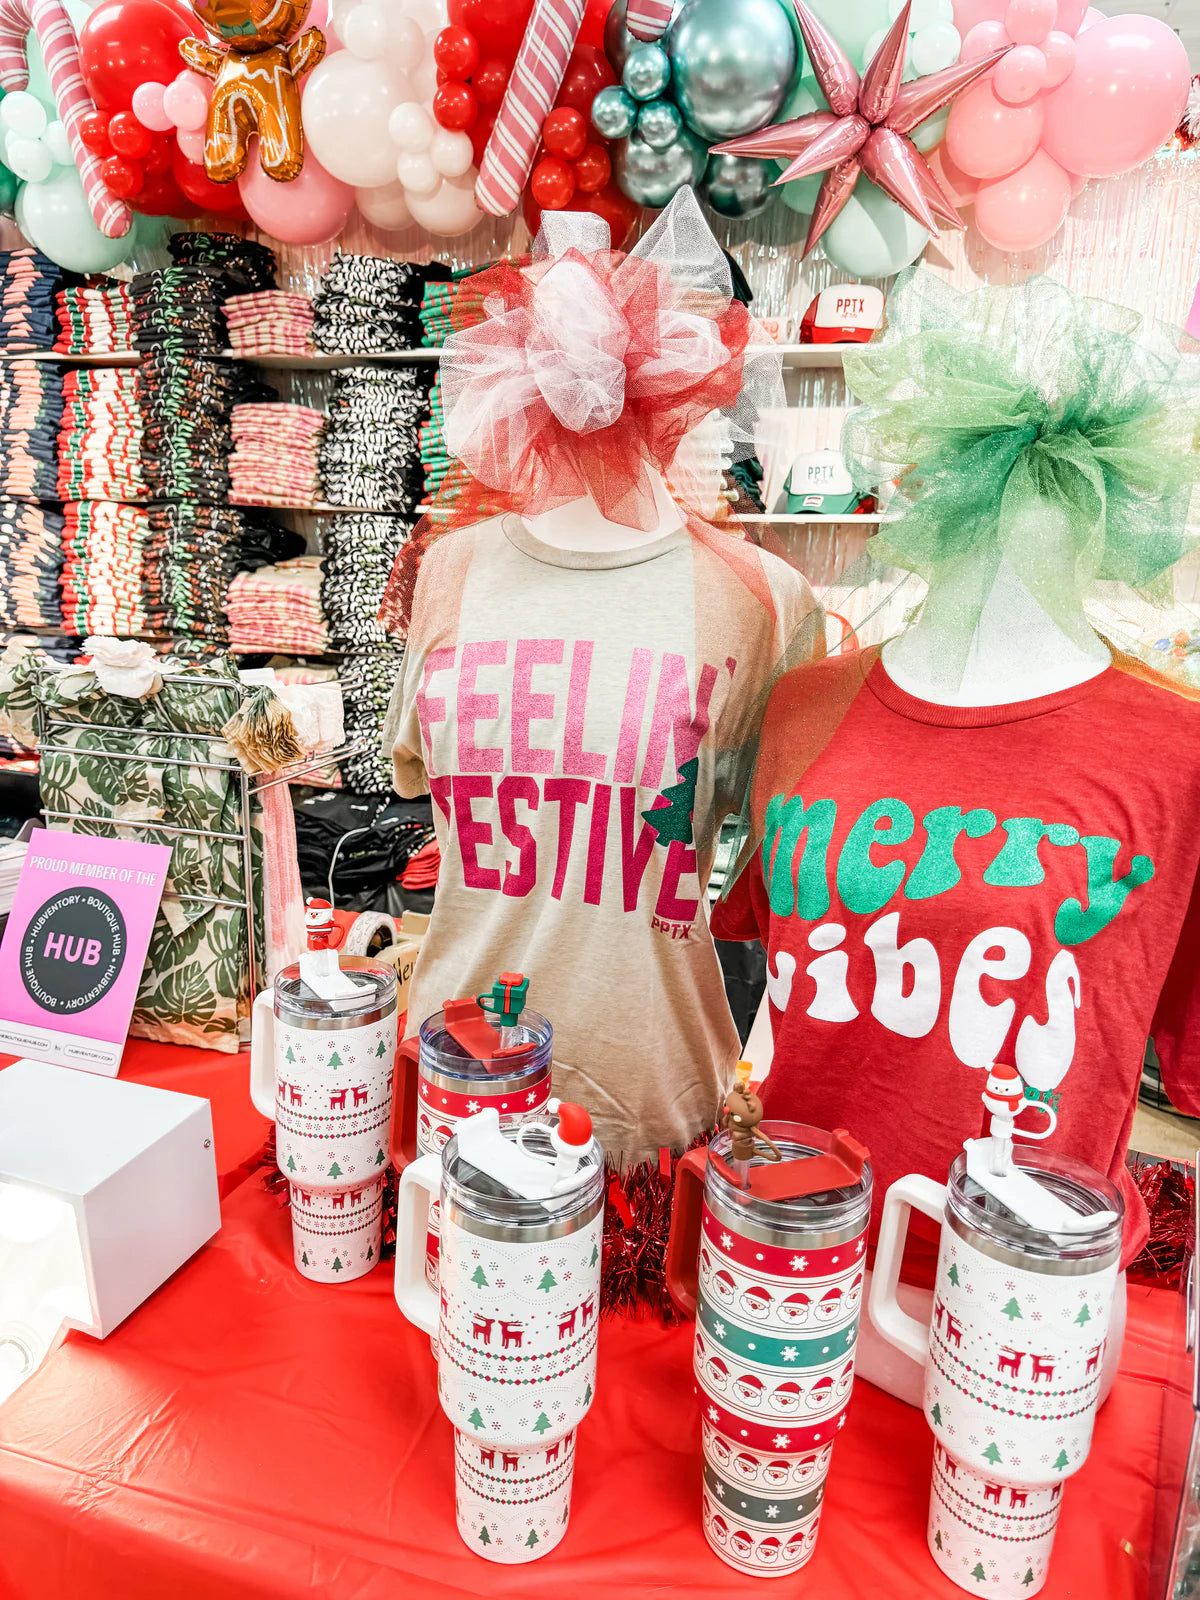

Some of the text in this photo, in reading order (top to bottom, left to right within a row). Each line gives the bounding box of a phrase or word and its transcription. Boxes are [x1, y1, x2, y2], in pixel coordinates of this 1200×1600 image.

[836, 298, 864, 313] PPTX
[807, 465, 834, 480] PPTX
[29, 855, 158, 887] PROUD MEMBER OF THE
[762, 792, 1155, 946] merry
[30, 894, 81, 938] HUBVENTORY
[86, 896, 121, 956] BOUTIQUE HUB
[650, 915, 692, 939] PPTX
[43, 932, 103, 966] HUB
[24, 945, 58, 1007] BOUTIQUE HUB
[65, 964, 116, 1009] HUBVENTORY
